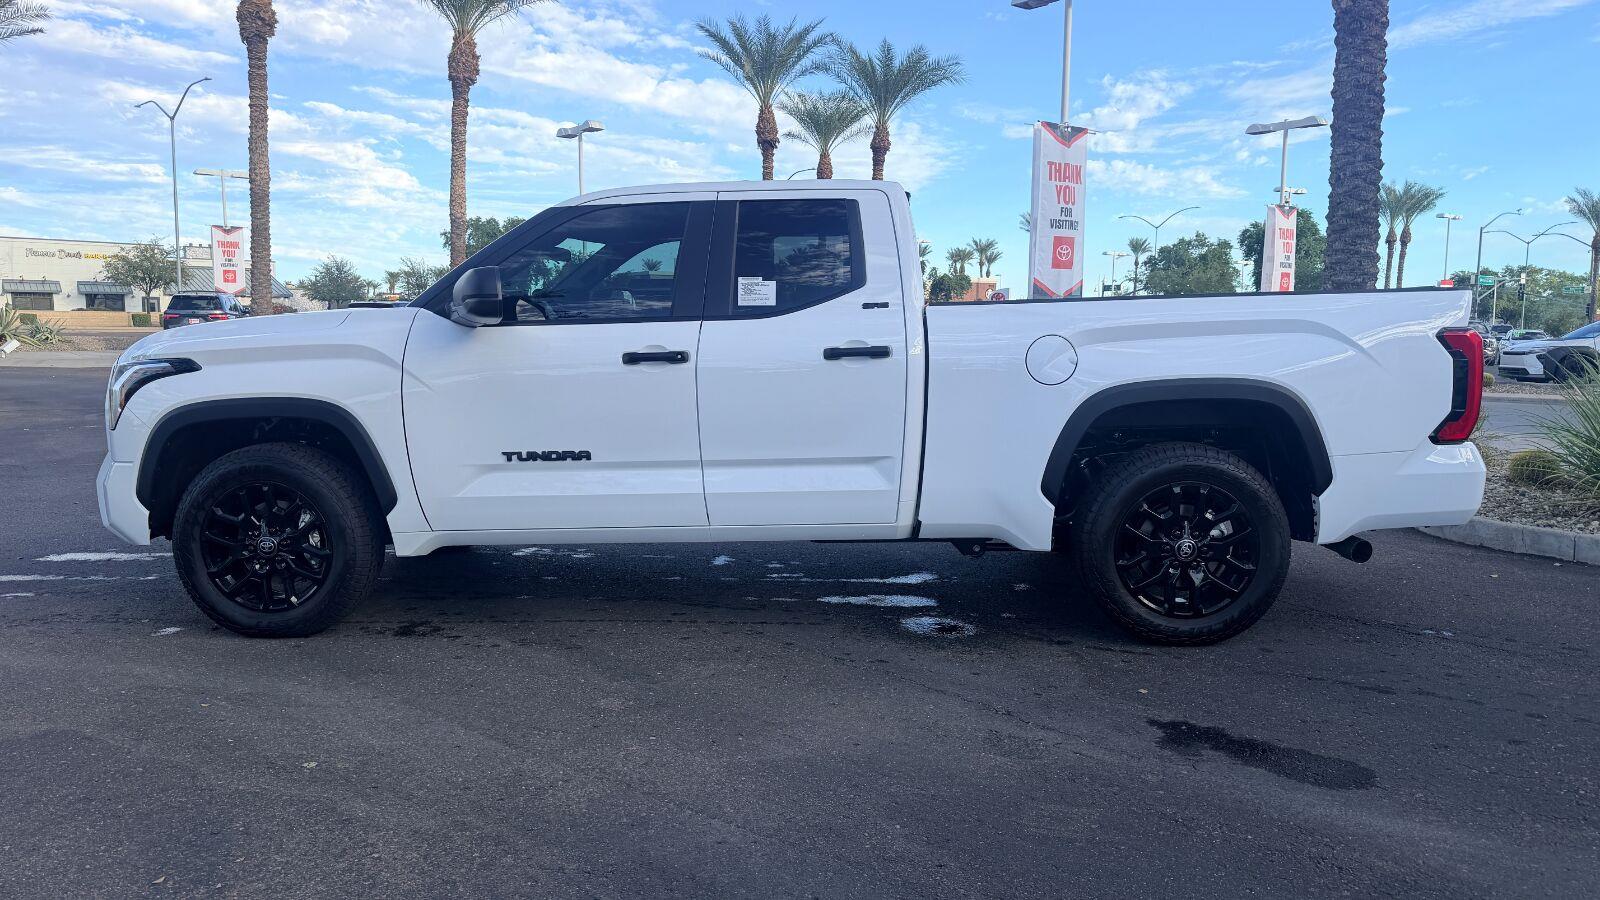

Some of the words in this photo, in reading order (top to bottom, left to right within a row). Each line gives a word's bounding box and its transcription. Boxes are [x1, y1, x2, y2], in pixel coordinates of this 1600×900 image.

[1056, 185, 1075, 206] YOU
[1060, 206, 1073, 218] FOR
[217, 240, 240, 249] THANK
[222, 249, 236, 258] YOU
[501, 451, 592, 462] TUNDRA
